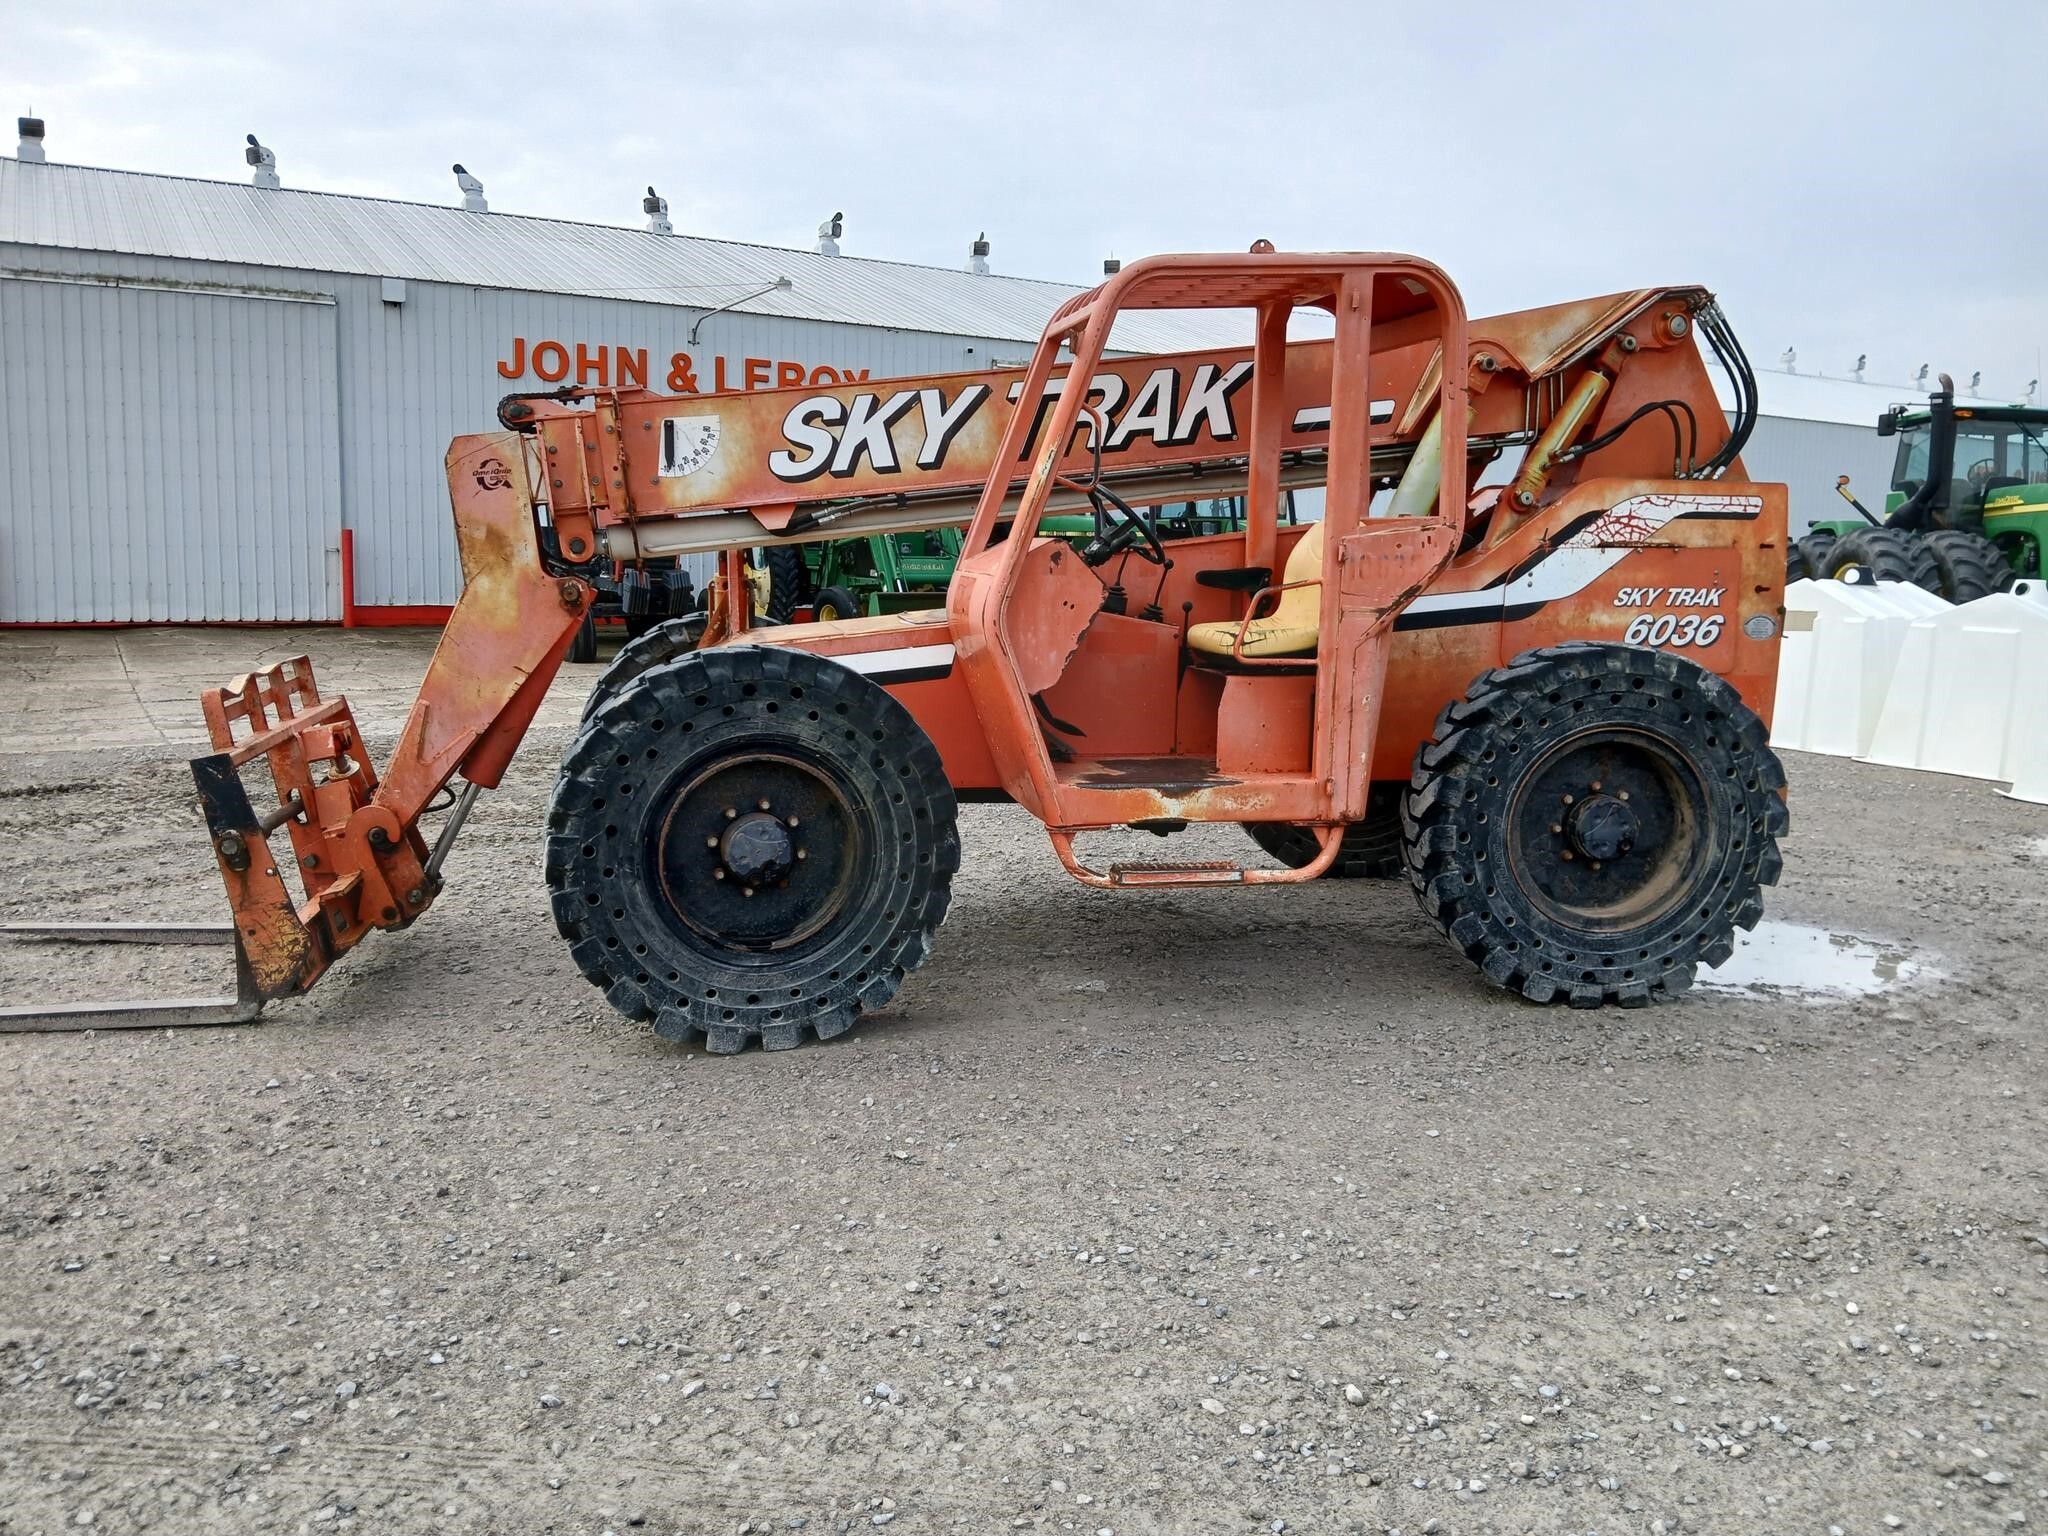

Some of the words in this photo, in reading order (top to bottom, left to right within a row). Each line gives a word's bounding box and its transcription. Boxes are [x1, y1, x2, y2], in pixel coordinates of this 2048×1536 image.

[497, 337, 647, 388] JOHN
[667, 352, 698, 393] &
[768, 383, 992, 484] SKY
[1613, 587, 1665, 607] SKY
[1665, 587, 1727, 607] TRAK
[1624, 613, 1726, 647] 6036
